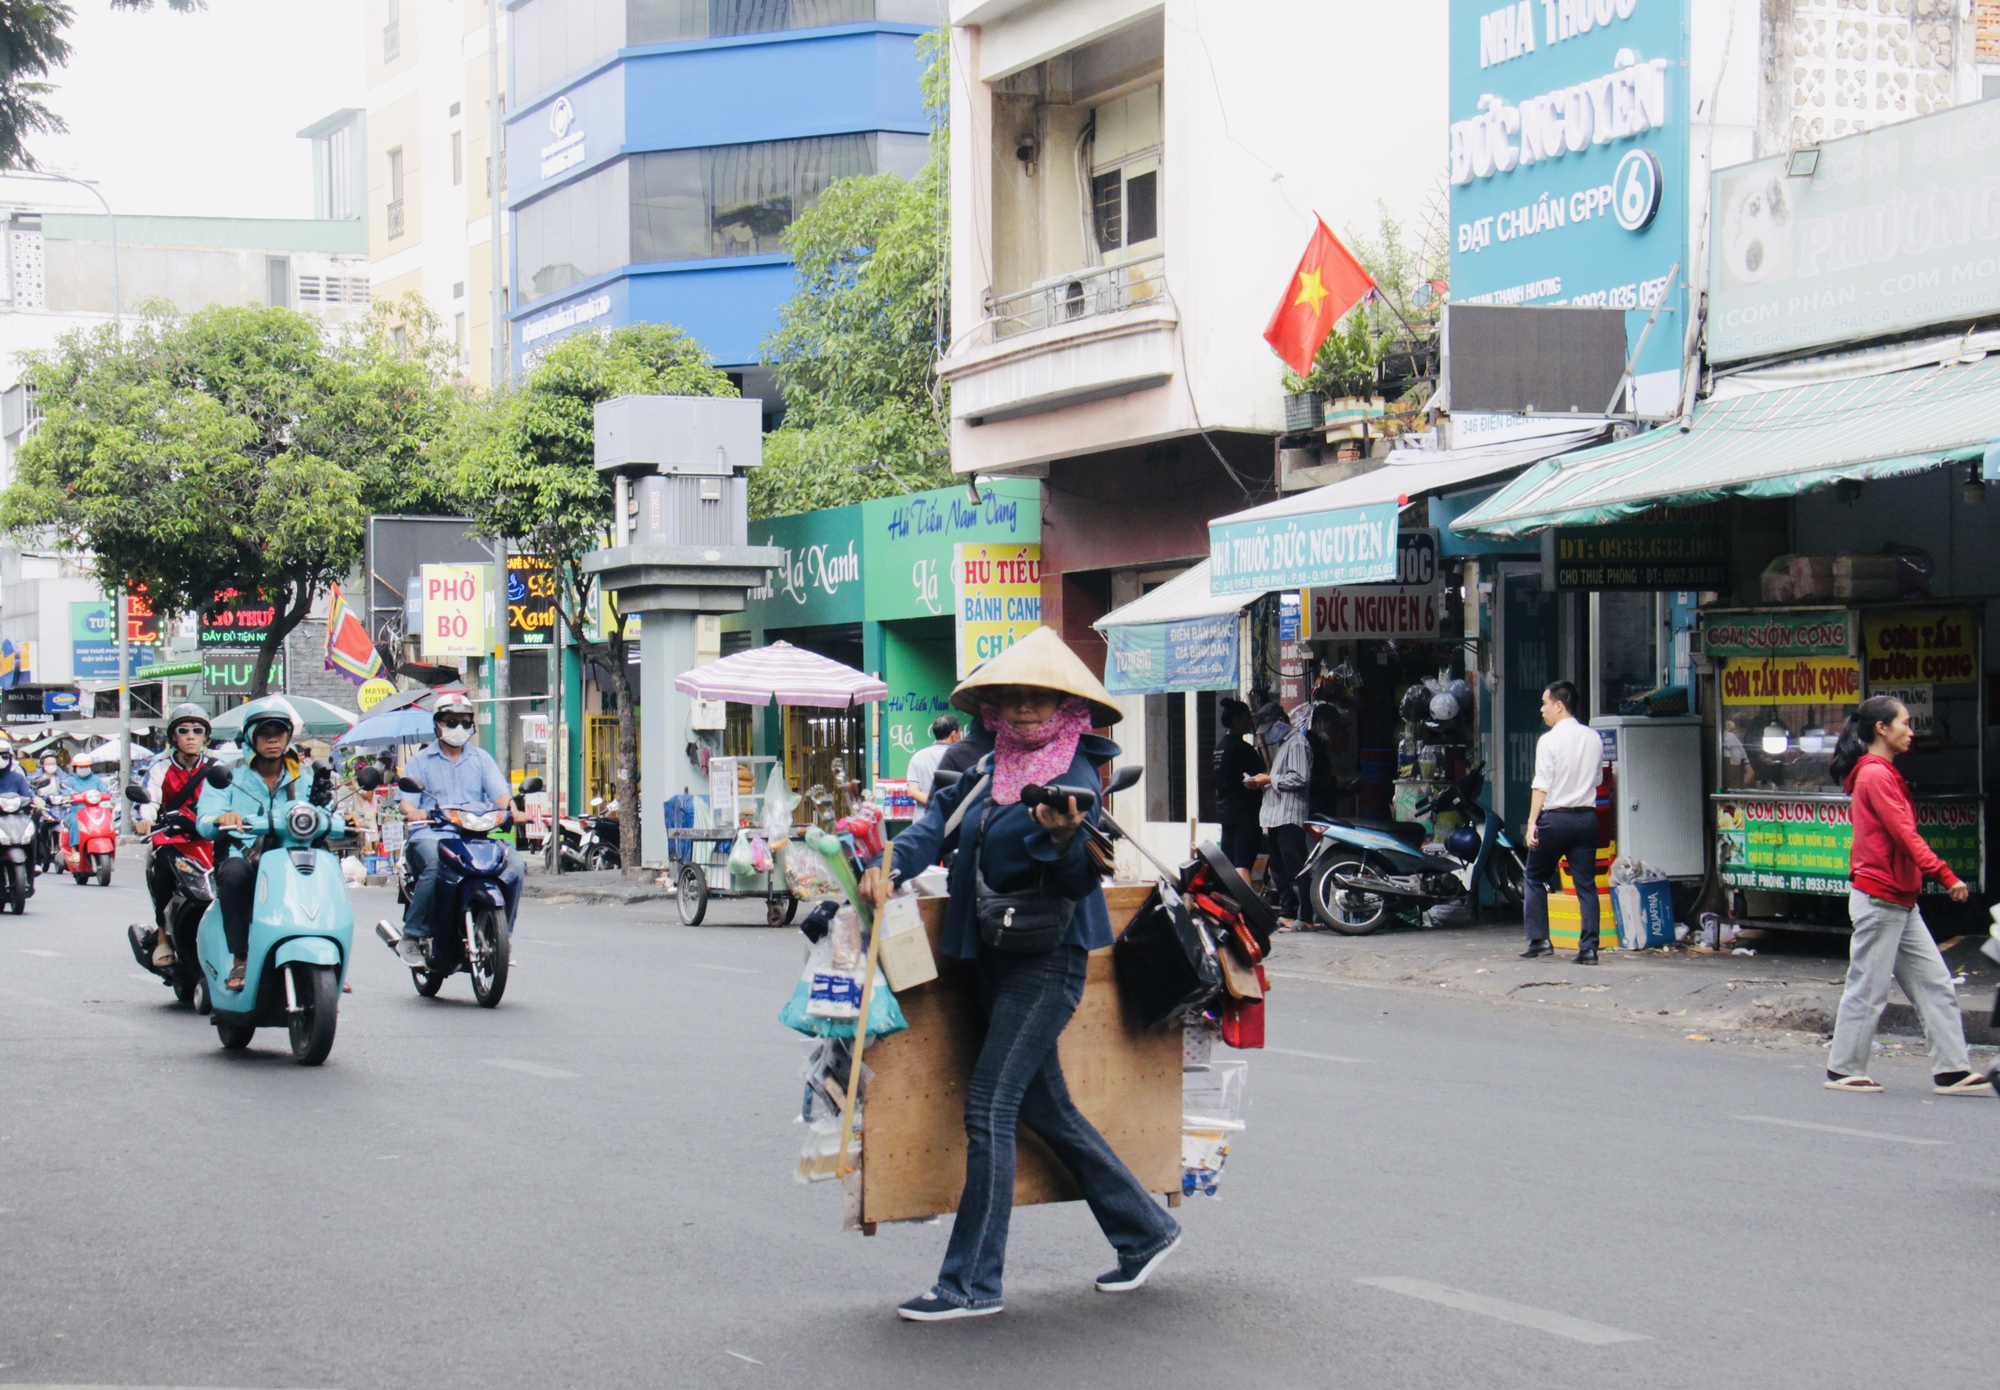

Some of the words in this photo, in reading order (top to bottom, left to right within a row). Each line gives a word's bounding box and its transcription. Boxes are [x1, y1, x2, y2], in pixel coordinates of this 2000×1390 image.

[1519, 48, 1666, 165] NGUYÊN
[1458, 217, 1494, 253] ĐẠT
[1570, 185, 1613, 222] GPP
[1951, 252, 2000, 282] MÓ
[1609, 283, 1637, 307] 035
[1463, 419, 1478, 436] 346
[1233, 526, 1270, 574] THUỐC
[1272, 521, 1306, 570] ĐỨC
[1309, 511, 1383, 567] NGUYÊN
[1387, 518, 1395, 557] 6
[1560, 538, 1593, 559] ĐT:
[808, 539, 859, 594] Xanh
[965, 549, 991, 584] HỦ
[997, 548, 1041, 584] TIẾU
[1560, 569, 1578, 585] CHO
[1581, 565, 1603, 585] THUÊ
[1607, 564, 1637, 584] PHÒNG
[429, 571, 476, 601] PHỞ
[965, 591, 1002, 622] BÁNH
[1007, 597, 1041, 622] CANH
[1316, 588, 1348, 632] ĐỨC
[1354, 587, 1420, 633] NGUYÊN
[1425, 595, 1434, 632] 6
[437, 608, 468, 638] BÒ
[1747, 620, 1792, 647] SƯỜN
[1797, 623, 1845, 651] CỌNG
[1879, 623, 1918, 651] CƠM
[1921, 615, 1961, 649] TẤM
[976, 628, 1028, 659] CHÁ
[1725, 665, 1751, 697] CƠM
[1752, 658, 1780, 697] TẤM
[1782, 661, 1817, 696] SƯỜN
[1819, 667, 1856, 701] CỌNG
[1869, 650, 1919, 681] SƯỜN
[1922, 654, 1973, 682] CỌNG
[1941, 803, 1977, 830] CỌNG
[1736, 870, 1756, 887] THUÊ
[1758, 872, 1785, 889] PHÒNG
[1648, 891, 1664, 937] AQUAFINA
